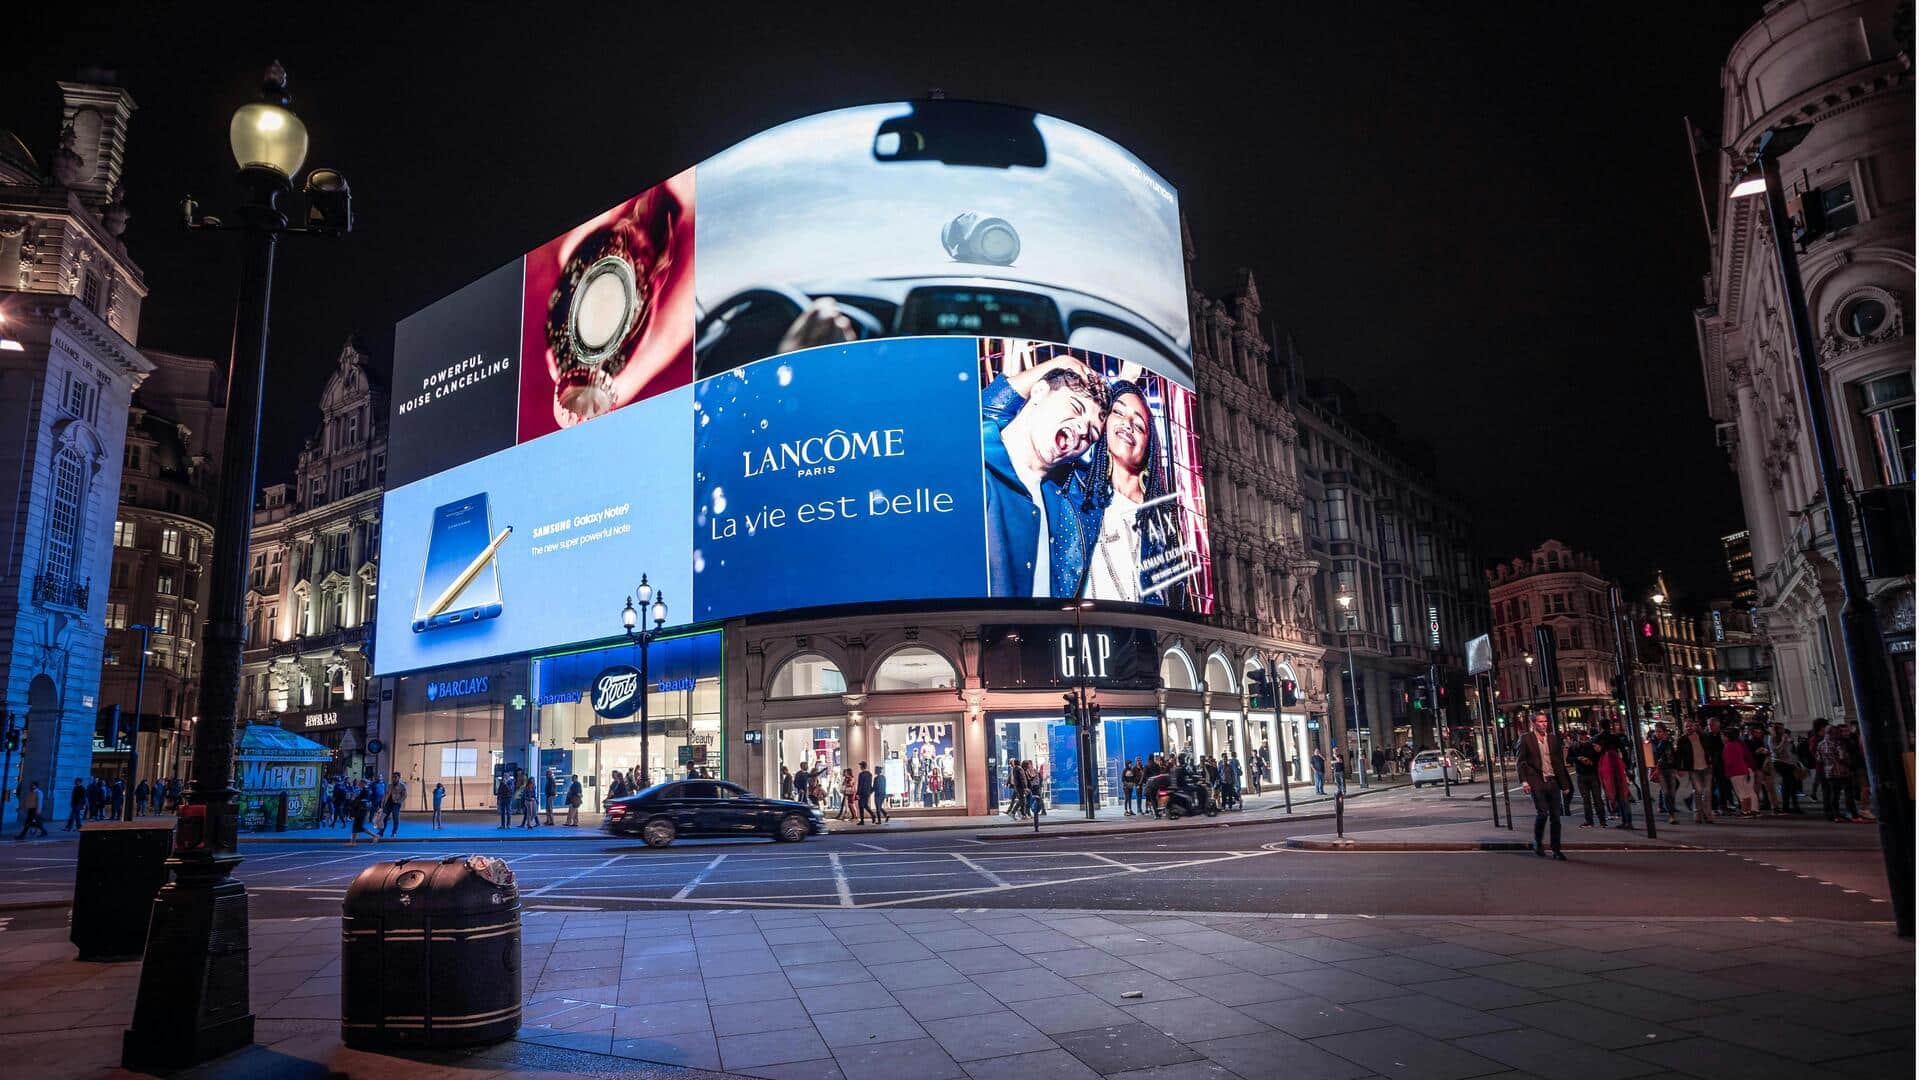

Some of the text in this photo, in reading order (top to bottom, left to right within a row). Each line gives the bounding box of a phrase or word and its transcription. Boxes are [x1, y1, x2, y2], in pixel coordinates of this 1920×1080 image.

[399, 357, 510, 415] NOISE CANCELLING
[423, 354, 483, 389] POWERFUL
[742, 428, 905, 478] LANCÔME
[797, 465, 836, 478] PARIS
[532, 503, 630, 539] SAMSUNG Galaxy Note9
[711, 487, 954, 541] La vie est belle
[531, 523, 632, 558] The new super powerful Note
[1060, 632, 1111, 679] GAP
[438, 677, 490, 698] BARCLAYS
[532, 690, 583, 708] pharmacy
[593, 672, 638, 711] Boots
[658, 677, 696, 693] beauty
[906, 722, 945, 745] GAP
